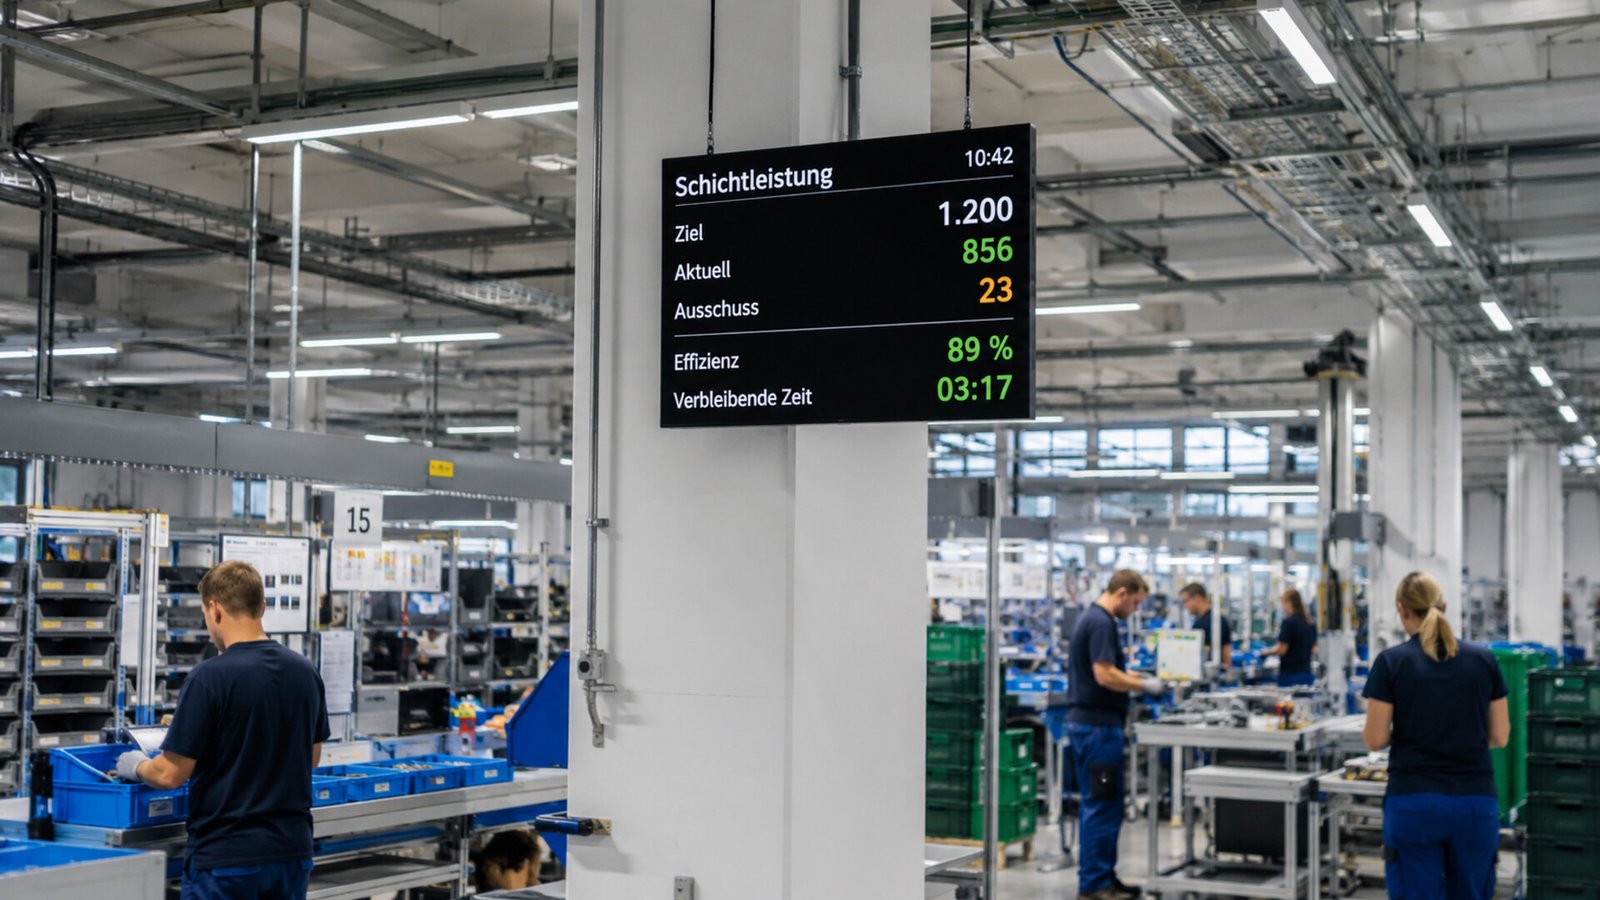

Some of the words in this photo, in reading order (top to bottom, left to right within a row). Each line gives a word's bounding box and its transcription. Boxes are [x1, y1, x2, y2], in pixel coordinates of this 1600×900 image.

[964, 146, 1014, 168] 10:42
[675, 164, 833, 197] Schichtleistung
[938, 195, 1014, 226] 1.200
[674, 223, 704, 243] Ziel
[962, 235, 1013, 265] 856
[674, 260, 731, 281] Aktuell
[979, 275, 1013, 304] 23
[674, 299, 760, 320] Ausschuss
[674, 352, 740, 371] Effizienz
[947, 336, 981, 363] 89
[989, 334, 1013, 361] %
[673, 388, 778, 409] Verbleibende
[781, 387, 813, 406] Zeit
[936, 374, 1013, 402] 03:17
[347, 506, 371, 534] 15
